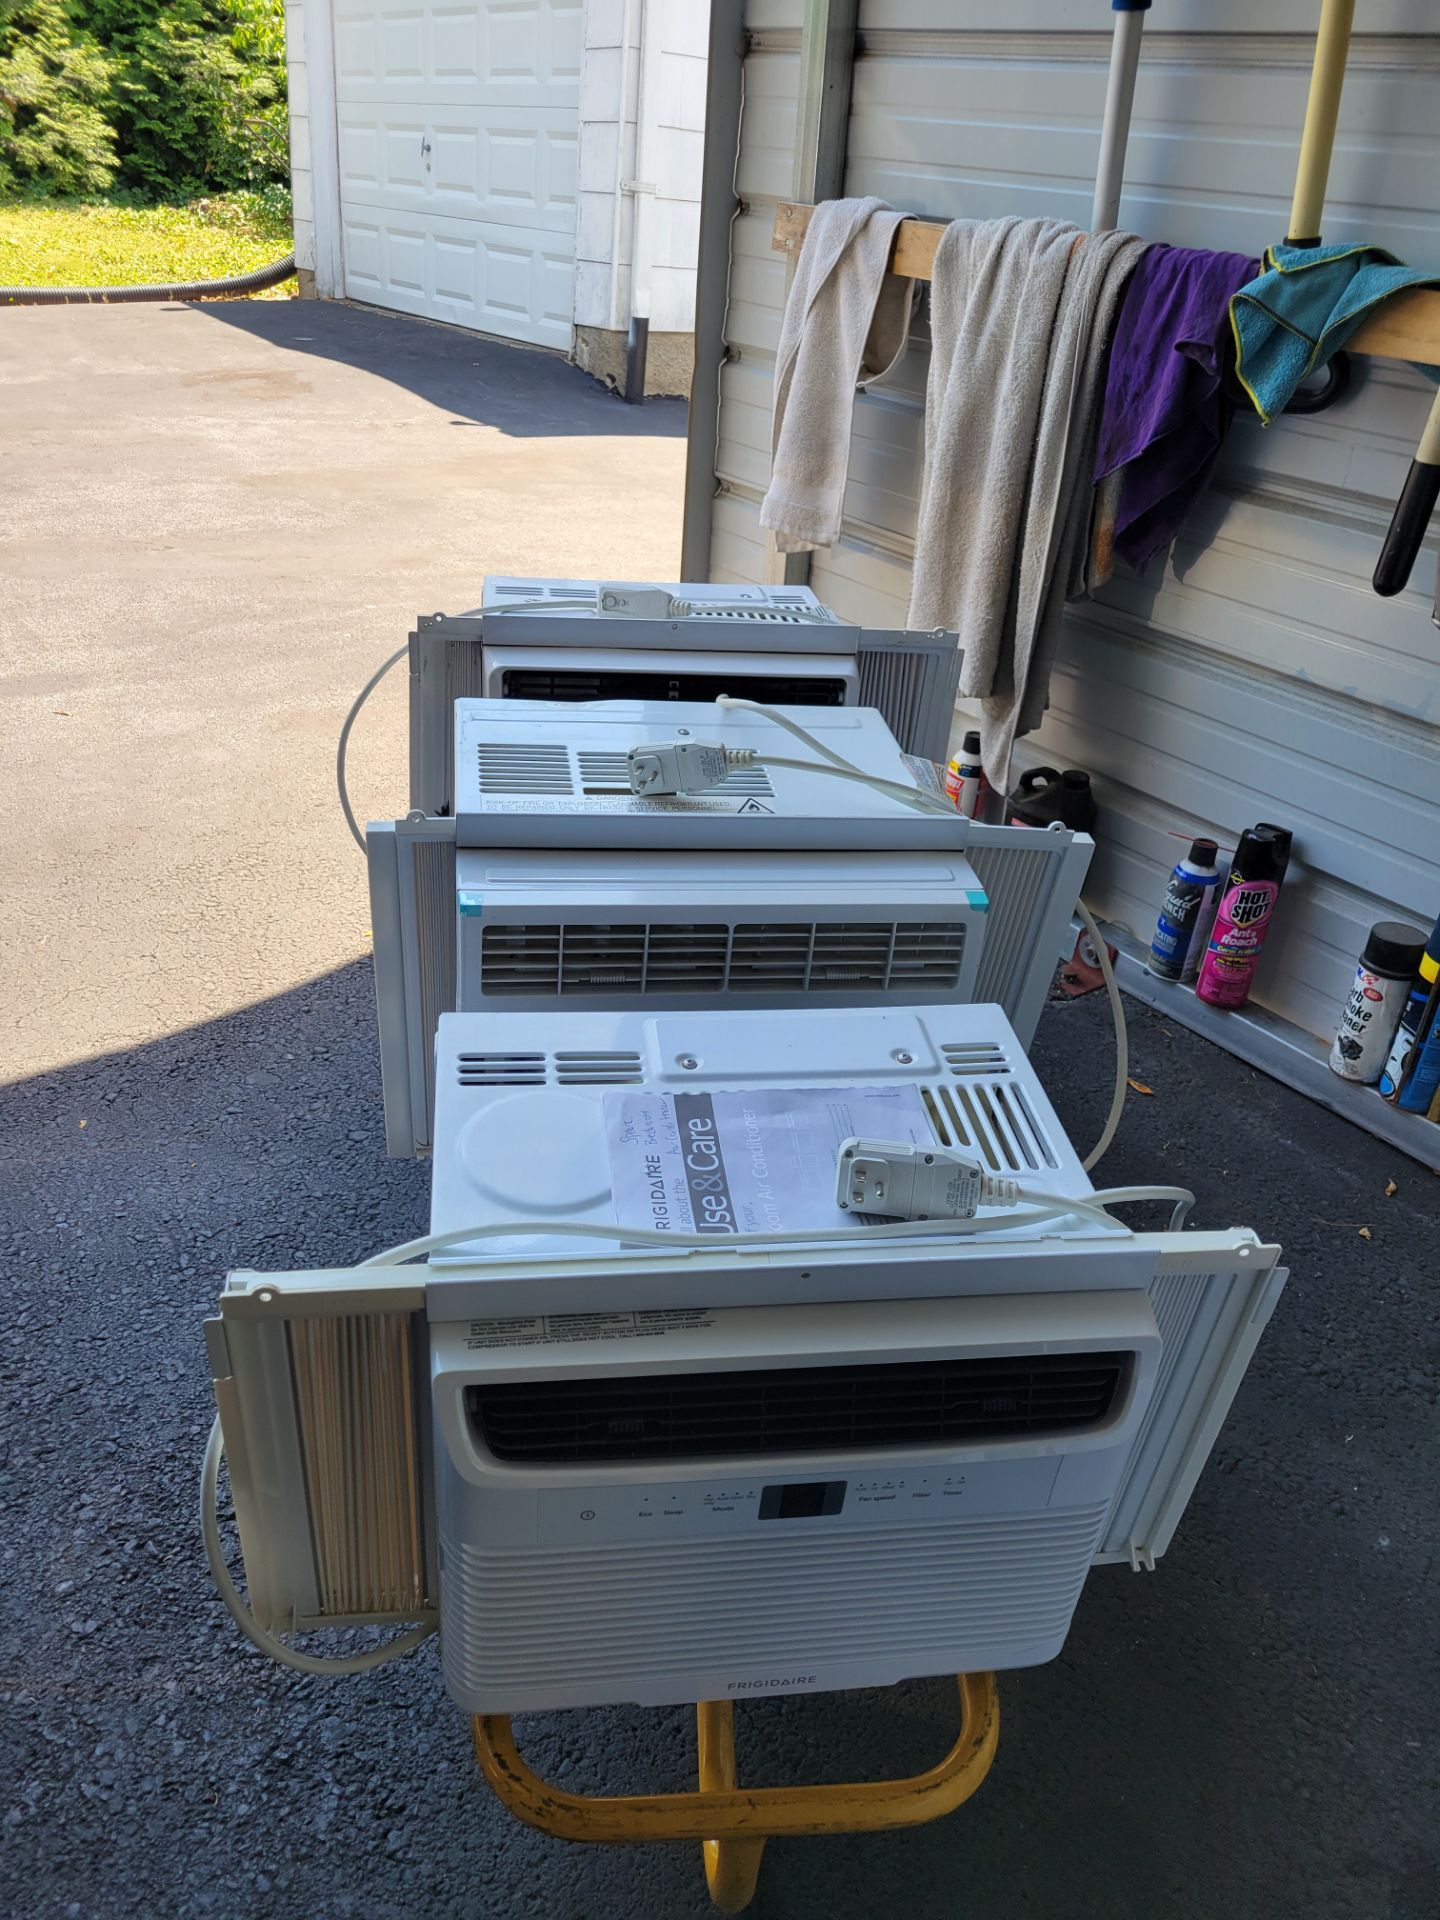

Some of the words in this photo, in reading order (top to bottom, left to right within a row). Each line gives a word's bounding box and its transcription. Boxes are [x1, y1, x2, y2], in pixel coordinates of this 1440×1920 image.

[1239, 888, 1272, 905] HOT
[1231, 902, 1272, 924] SHOT
[1221, 935, 1258, 946] Roach
[1350, 986, 1364, 1003] arb
[687, 1118, 720, 1171] Care
[742, 1107, 769, 1178] Conditioner
[645, 1154, 671, 1230] RIGIDAIRE
[672, 1178, 686, 1196] the
[691, 1172, 724, 1192] &
[756, 1182, 775, 1200] Air
[676, 1196, 692, 1225] about
[700, 1195, 734, 1234] Use
[763, 1203, 782, 1232] oom
[728, 1675, 816, 1690] FRIGIDAIRE
